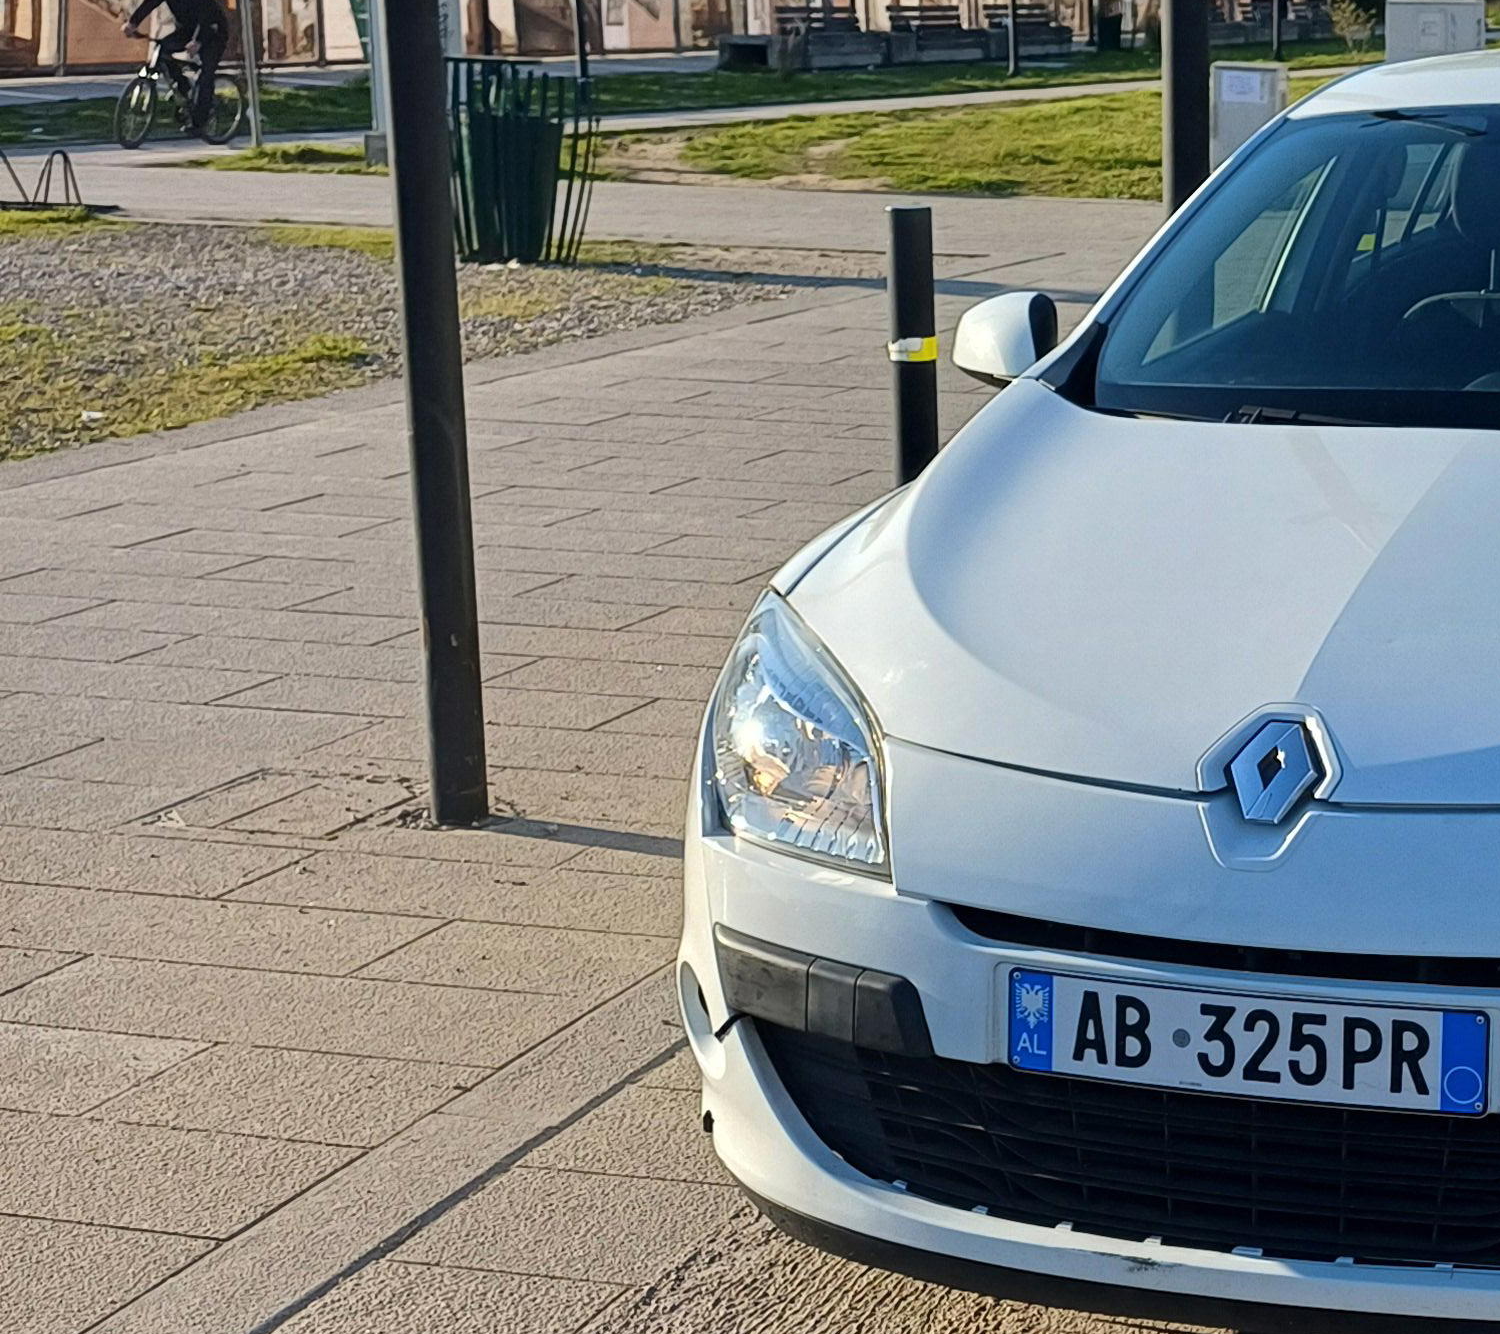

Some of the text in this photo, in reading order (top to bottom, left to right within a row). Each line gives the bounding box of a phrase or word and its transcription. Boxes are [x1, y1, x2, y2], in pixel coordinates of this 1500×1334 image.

[1017, 1032, 1047, 1055] AL
[1072, 989, 1430, 1095] AB 325PR
